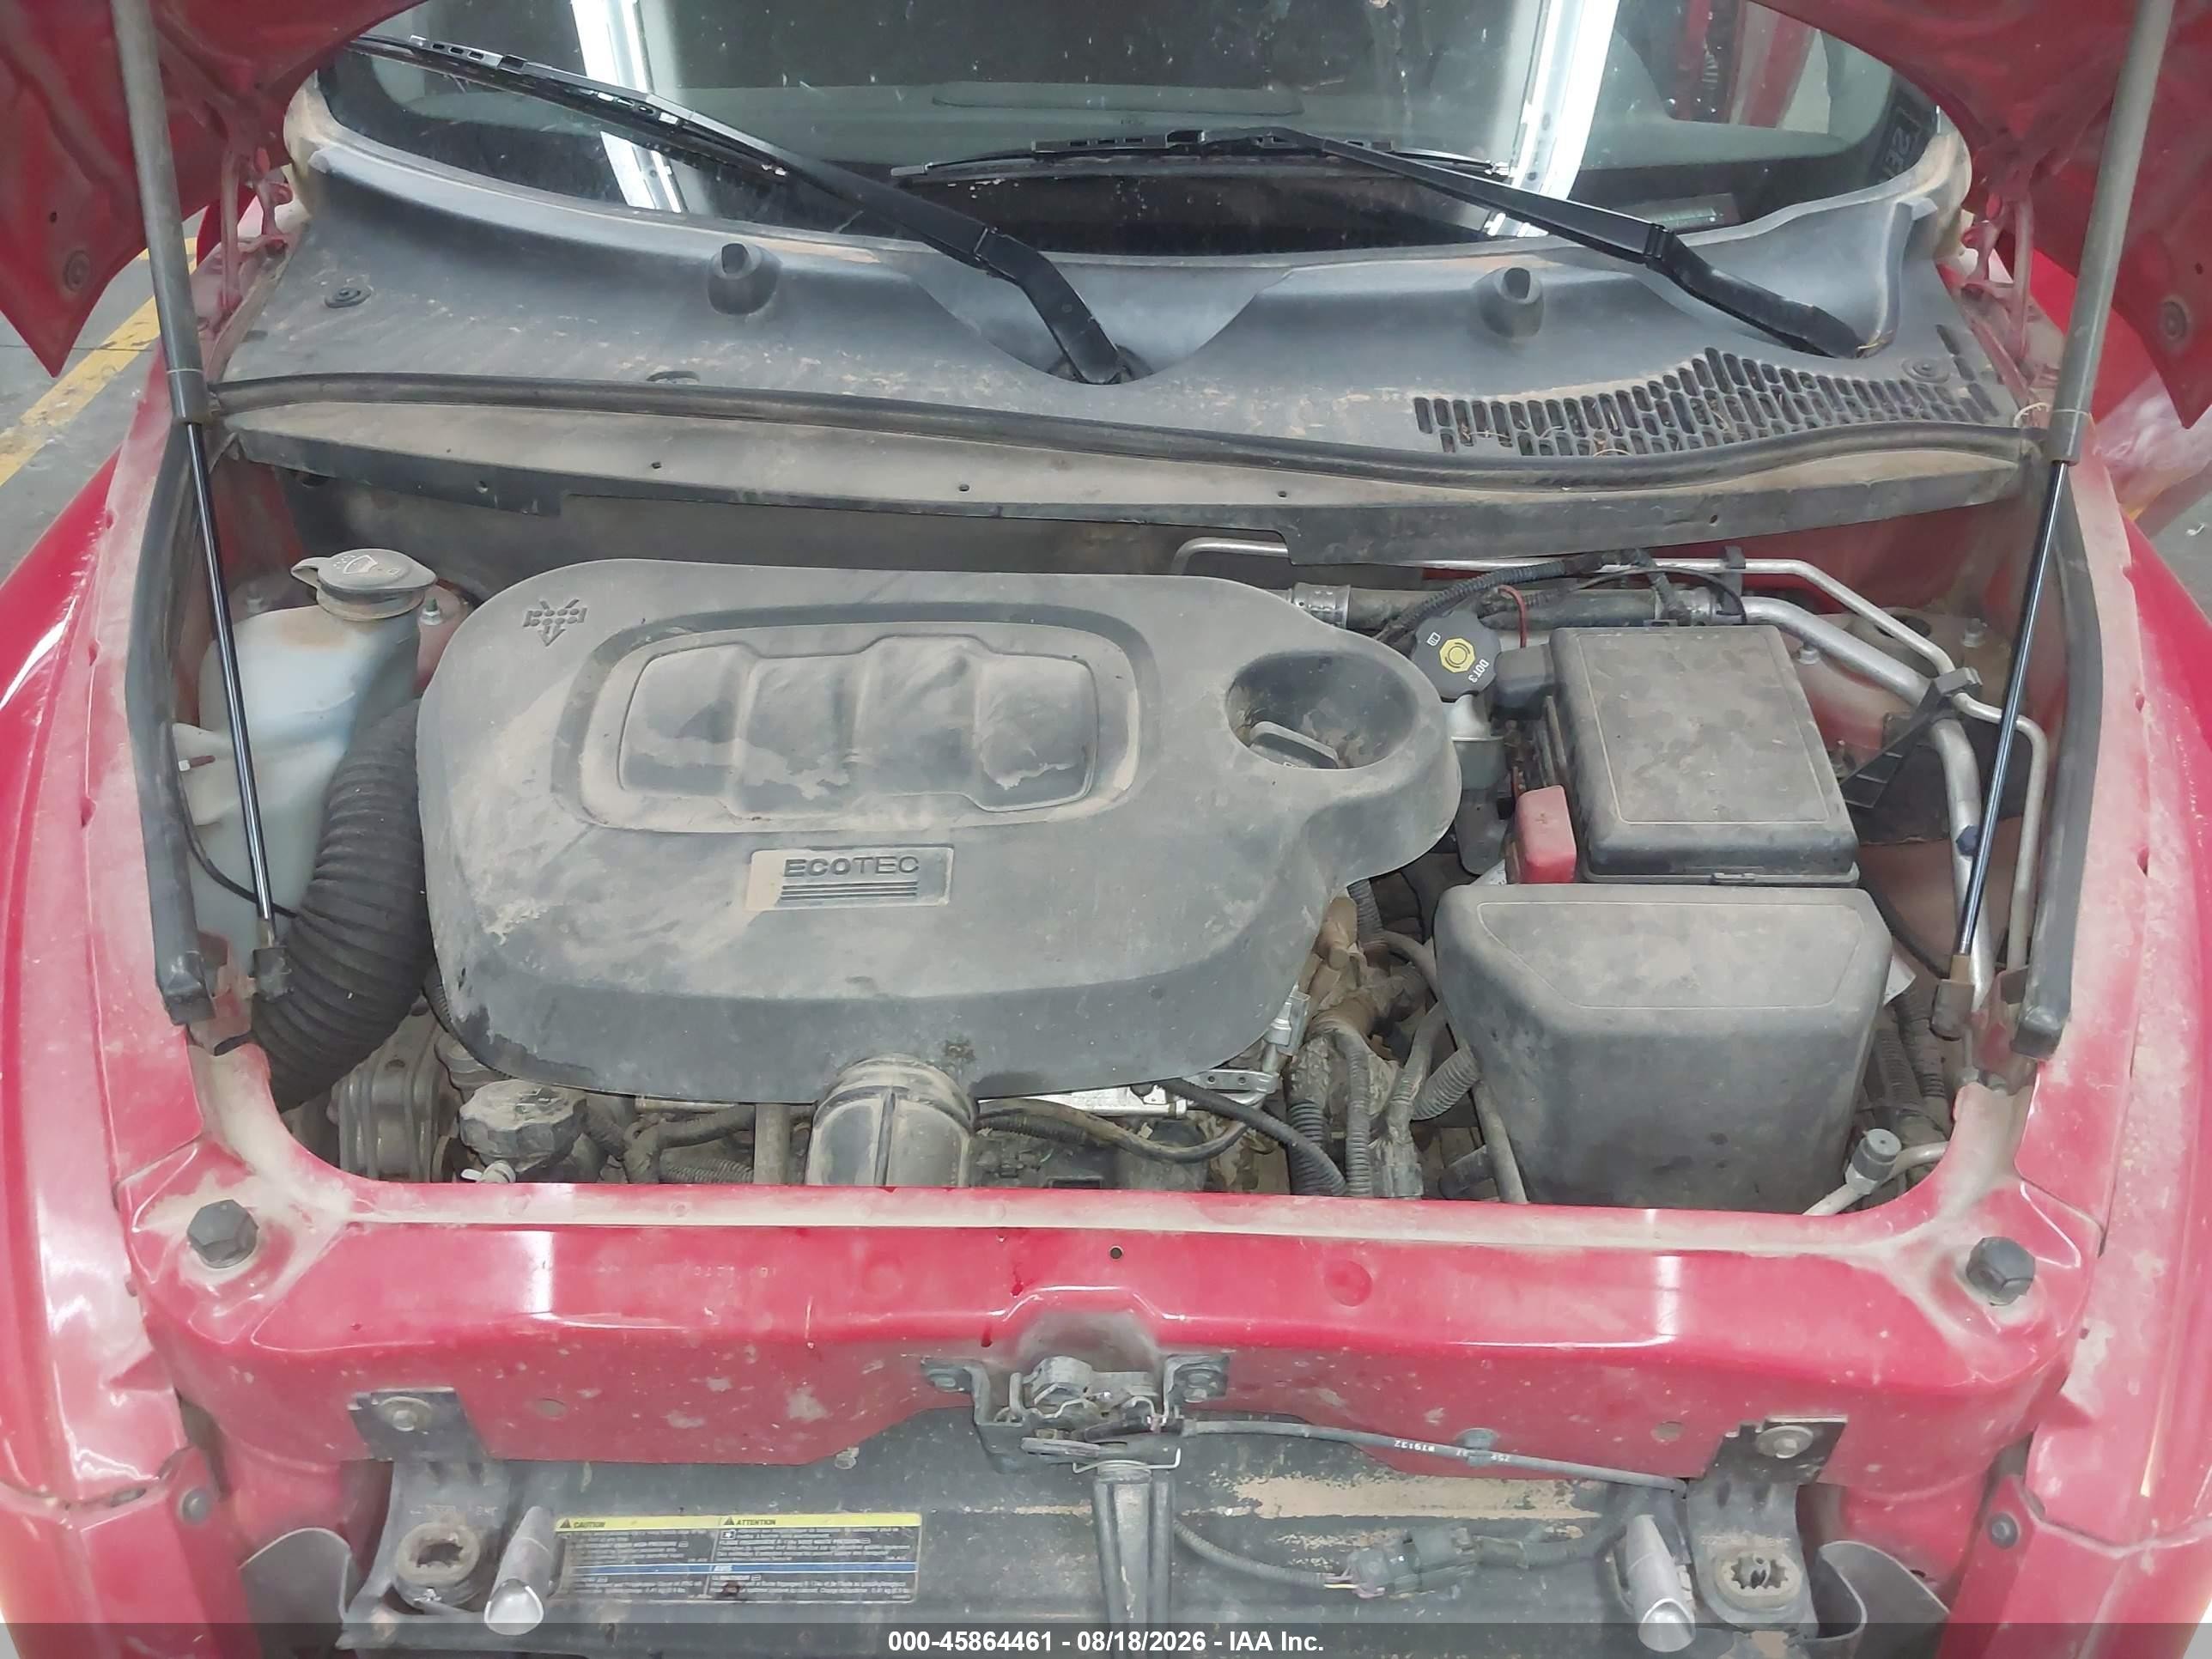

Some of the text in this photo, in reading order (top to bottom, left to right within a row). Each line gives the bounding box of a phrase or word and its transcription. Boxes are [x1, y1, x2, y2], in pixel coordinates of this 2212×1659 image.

[1468, 659, 1489, 683] DOT 3
[782, 855, 920, 878] ECOTEC
